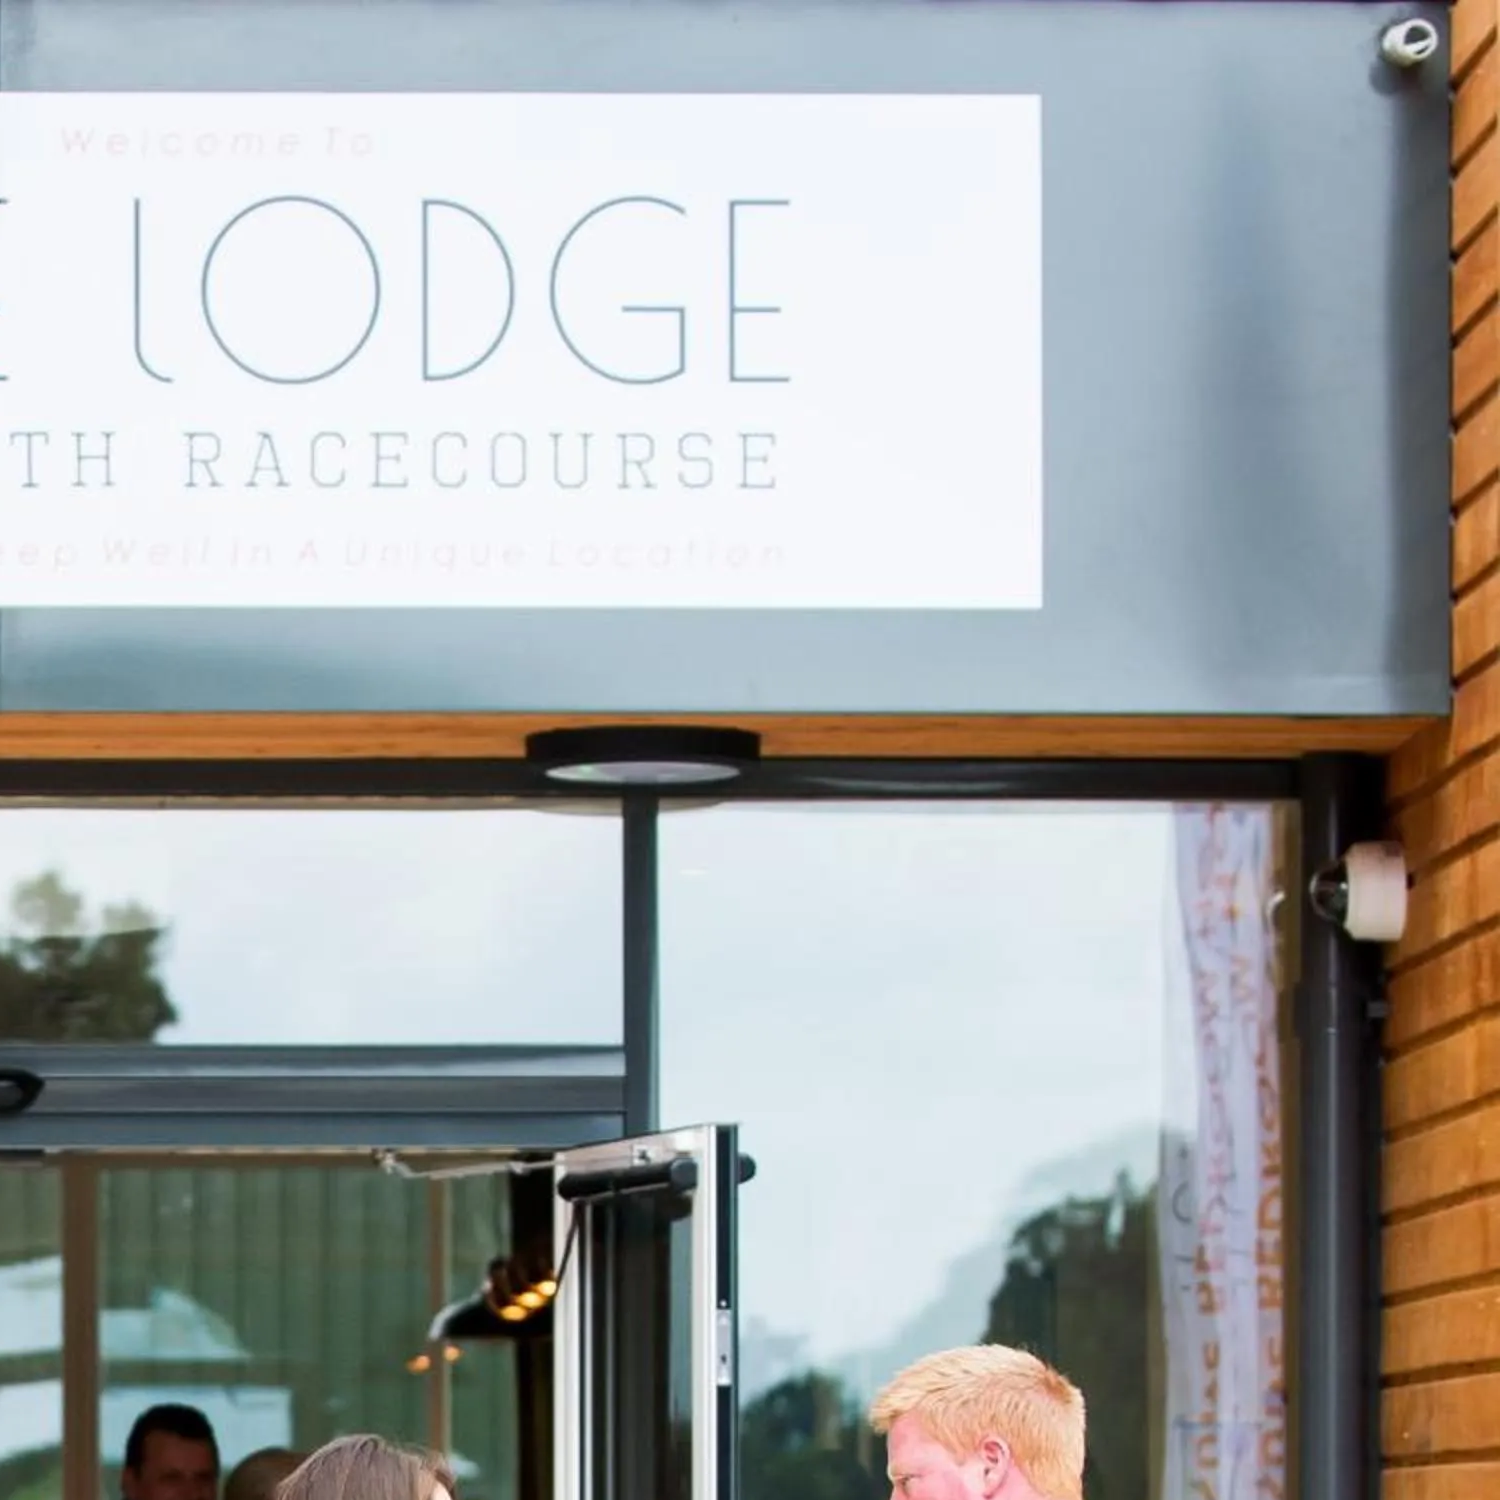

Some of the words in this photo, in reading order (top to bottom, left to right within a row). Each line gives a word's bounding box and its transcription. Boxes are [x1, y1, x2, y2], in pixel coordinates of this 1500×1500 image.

[60, 126, 301, 155] Welcome
[324, 126, 375, 155] To
[134, 194, 792, 386] LODGE
[182, 431, 776, 490] RACECOURSE
